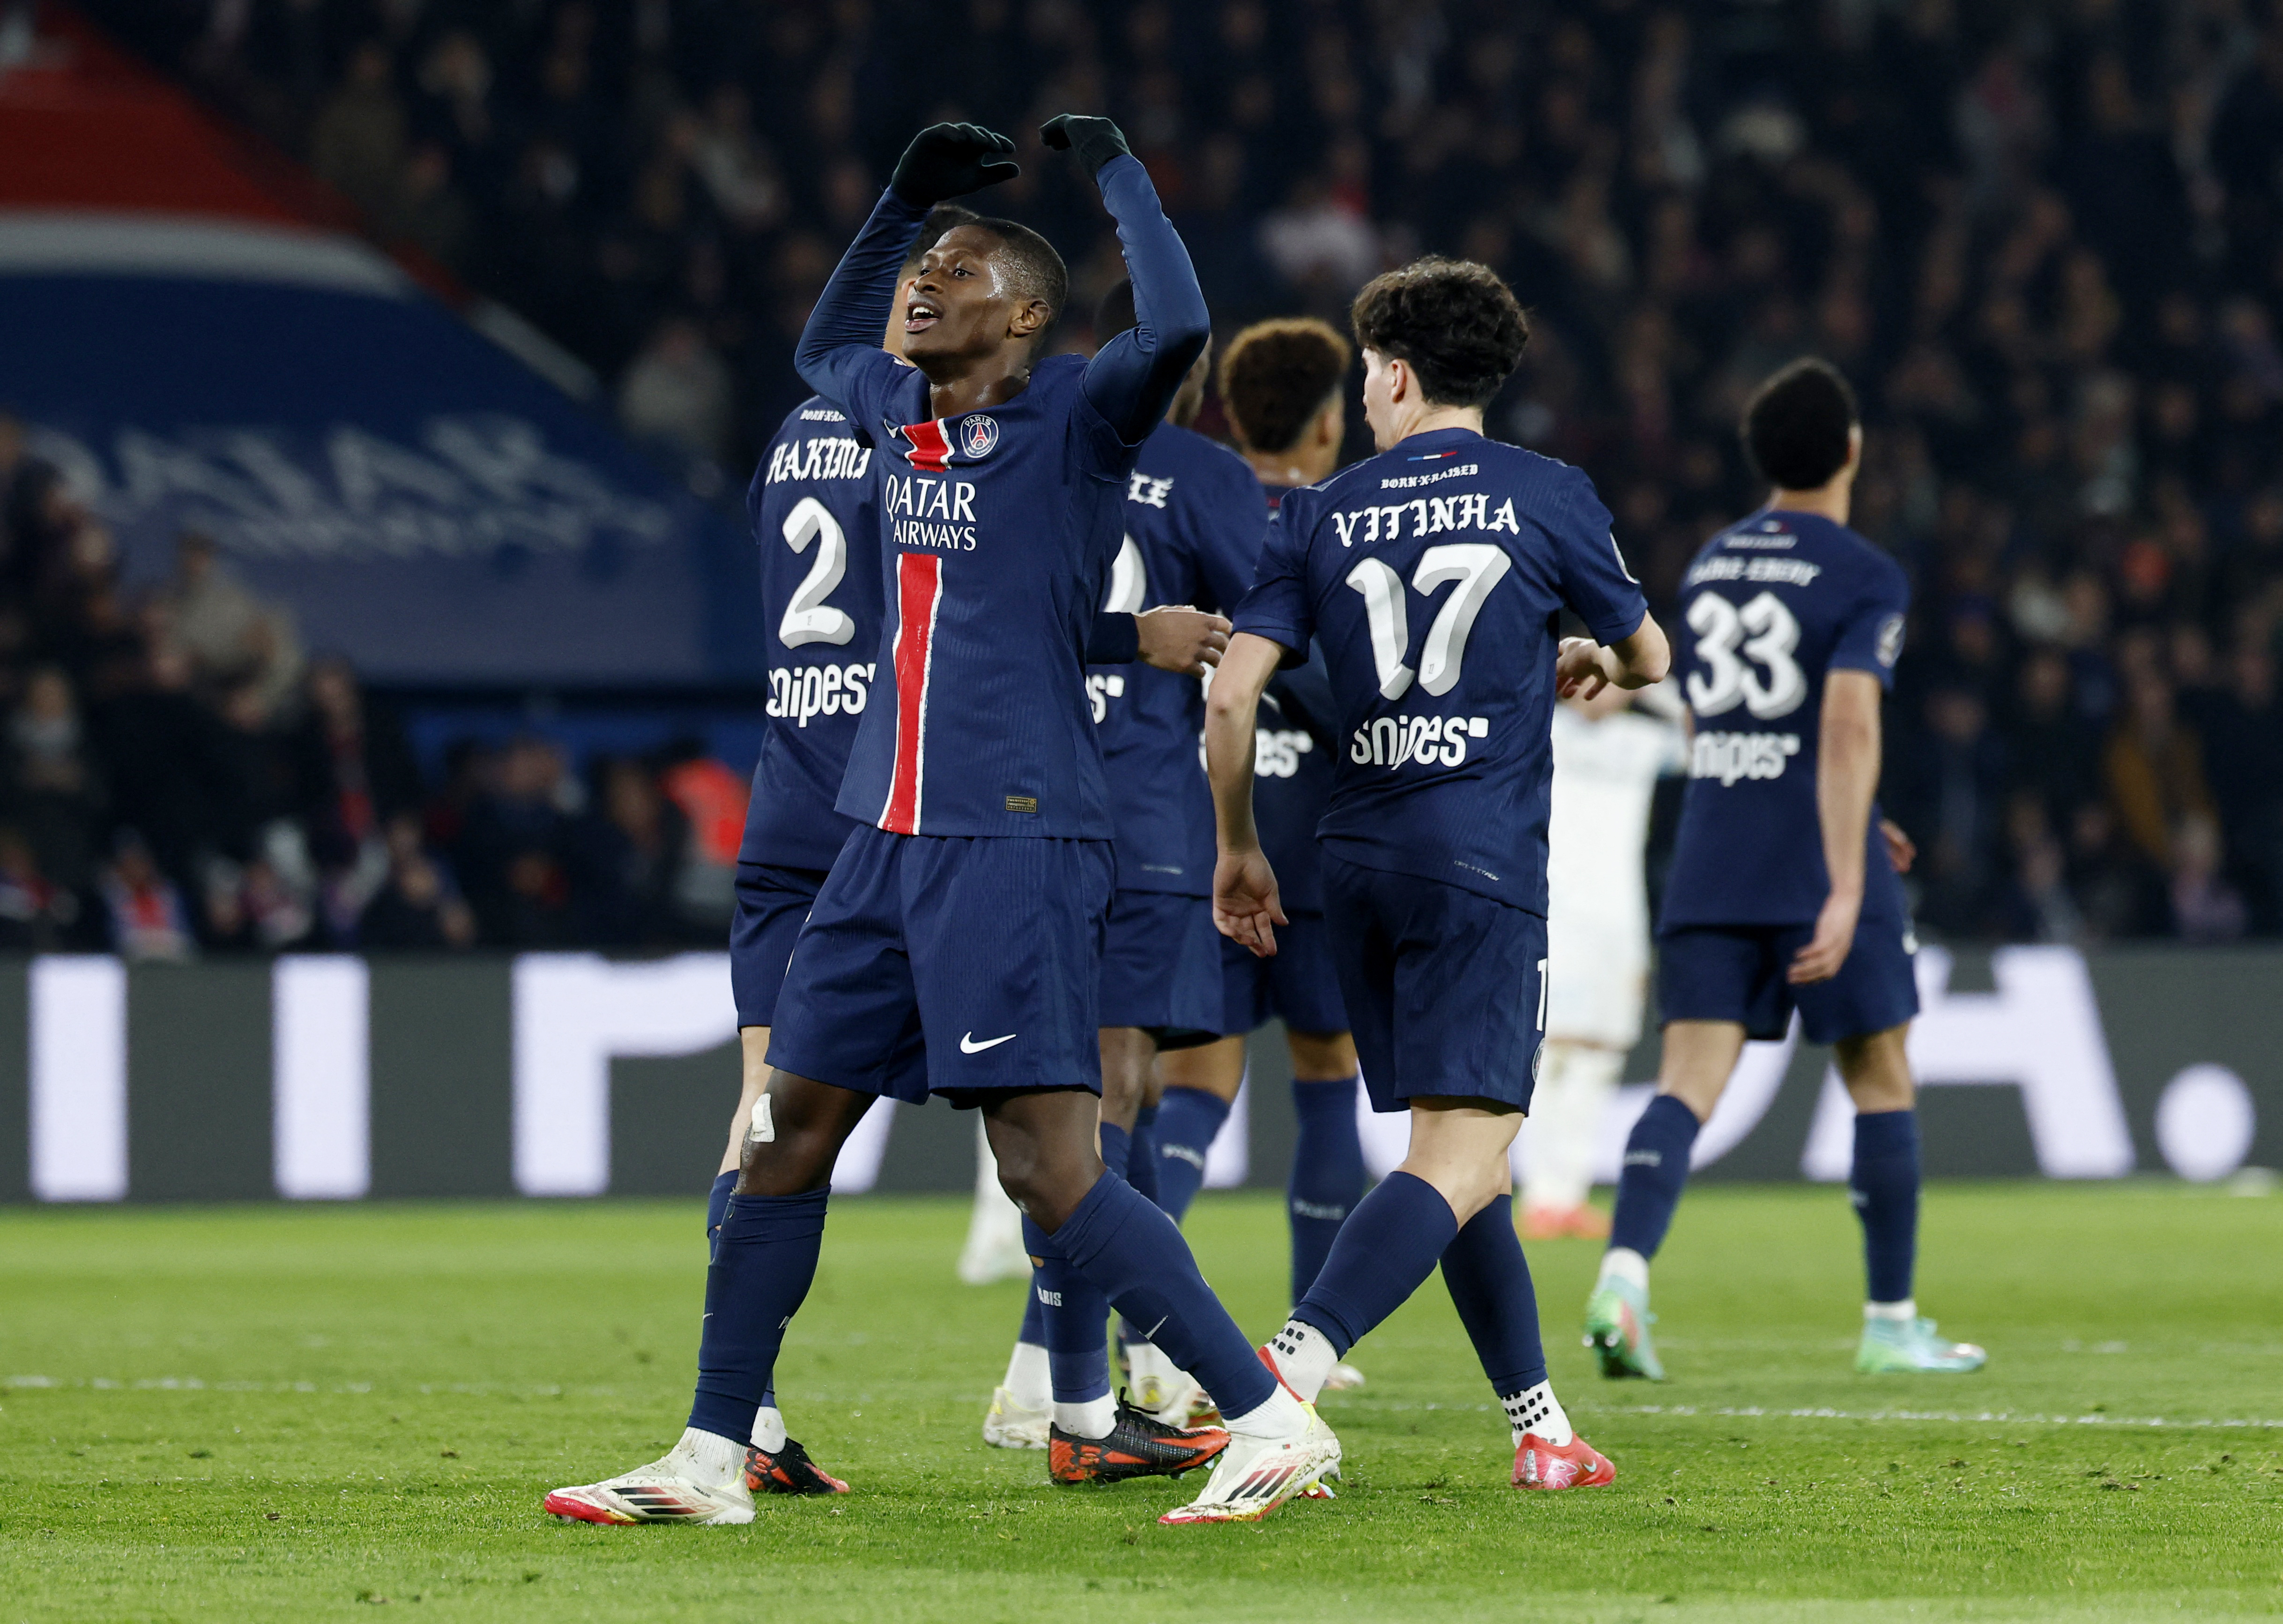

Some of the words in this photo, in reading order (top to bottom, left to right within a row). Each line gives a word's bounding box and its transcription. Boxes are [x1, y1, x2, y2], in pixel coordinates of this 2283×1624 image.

[964, 416, 991, 427] PARIS
[765, 436, 872, 482] HAKIMI
[885, 475, 977, 523] QATAR
[1331, 492, 1520, 548] VITINHA
[892, 520, 978, 551] AIRWAYS
[779, 496, 855, 650] 2
[1345, 543, 1512, 701] 17
[1686, 589, 1809, 720] 33
[1691, 730, 1787, 788] nipes
